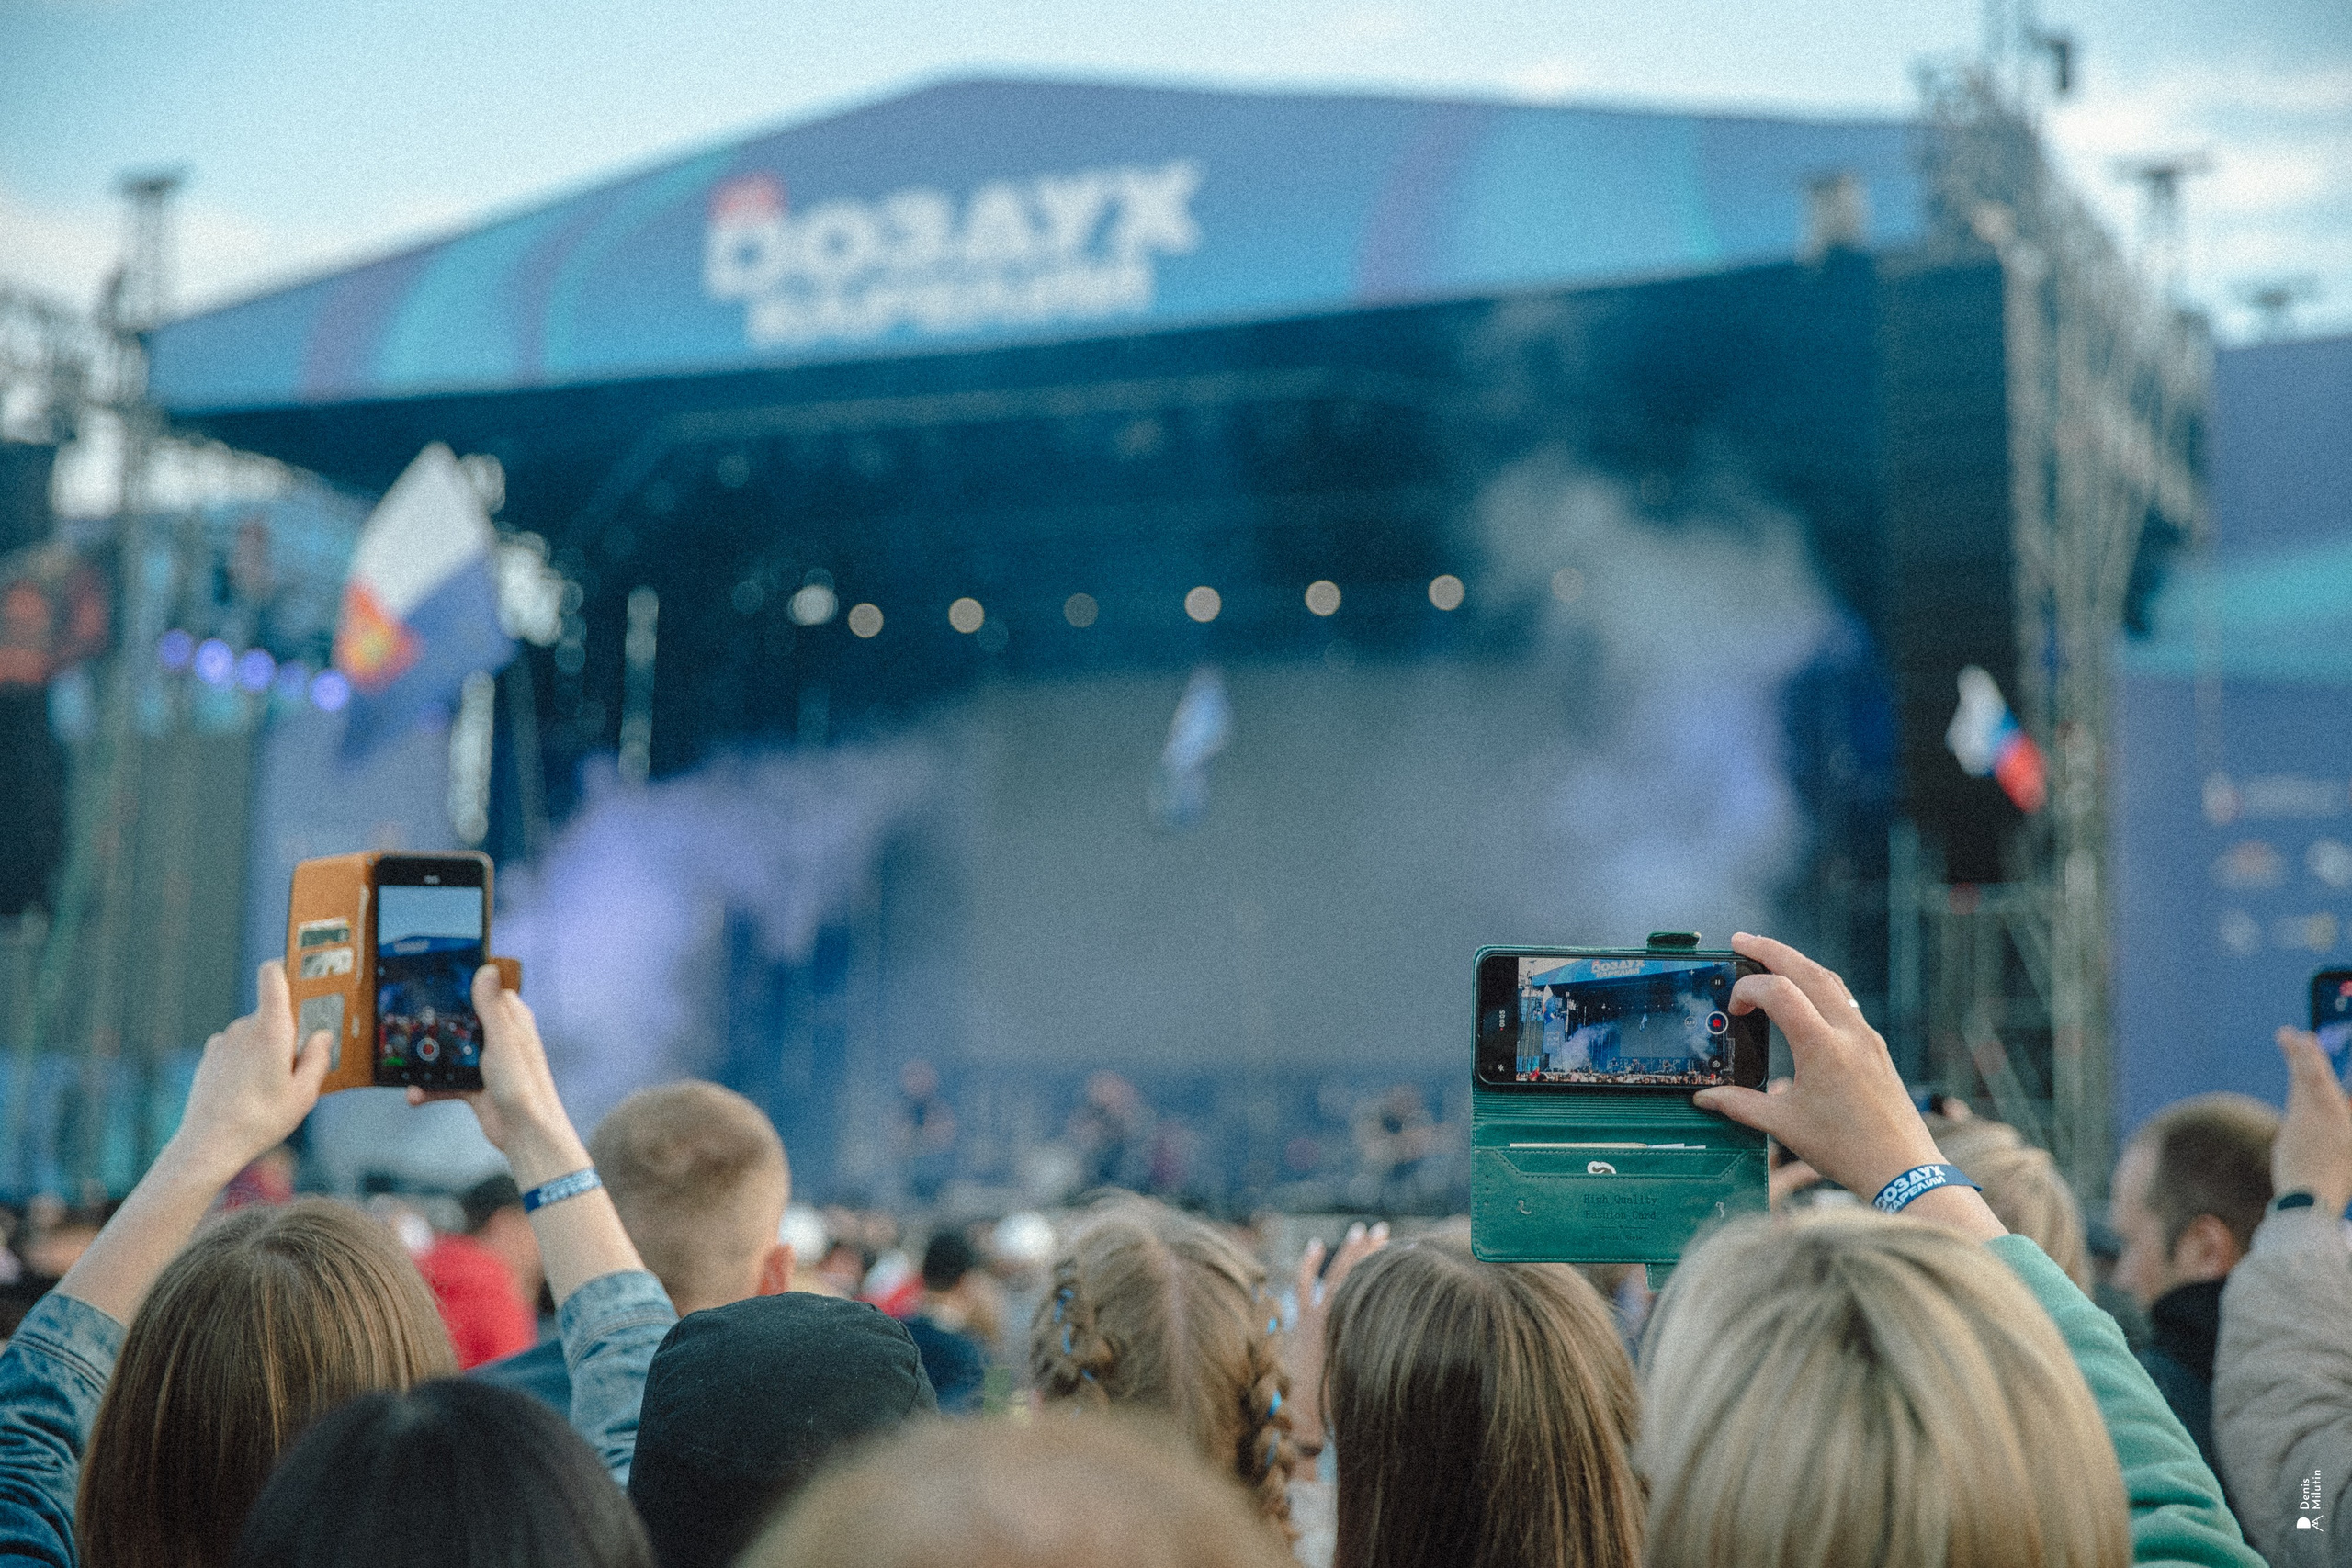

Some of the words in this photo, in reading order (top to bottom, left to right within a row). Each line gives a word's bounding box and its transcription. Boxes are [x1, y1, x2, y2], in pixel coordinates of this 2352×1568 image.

[1583, 1193, 1609, 1205] High
[1613, 1193, 1658, 1207] Quality
[1632, 1210, 1657, 1221] Card
